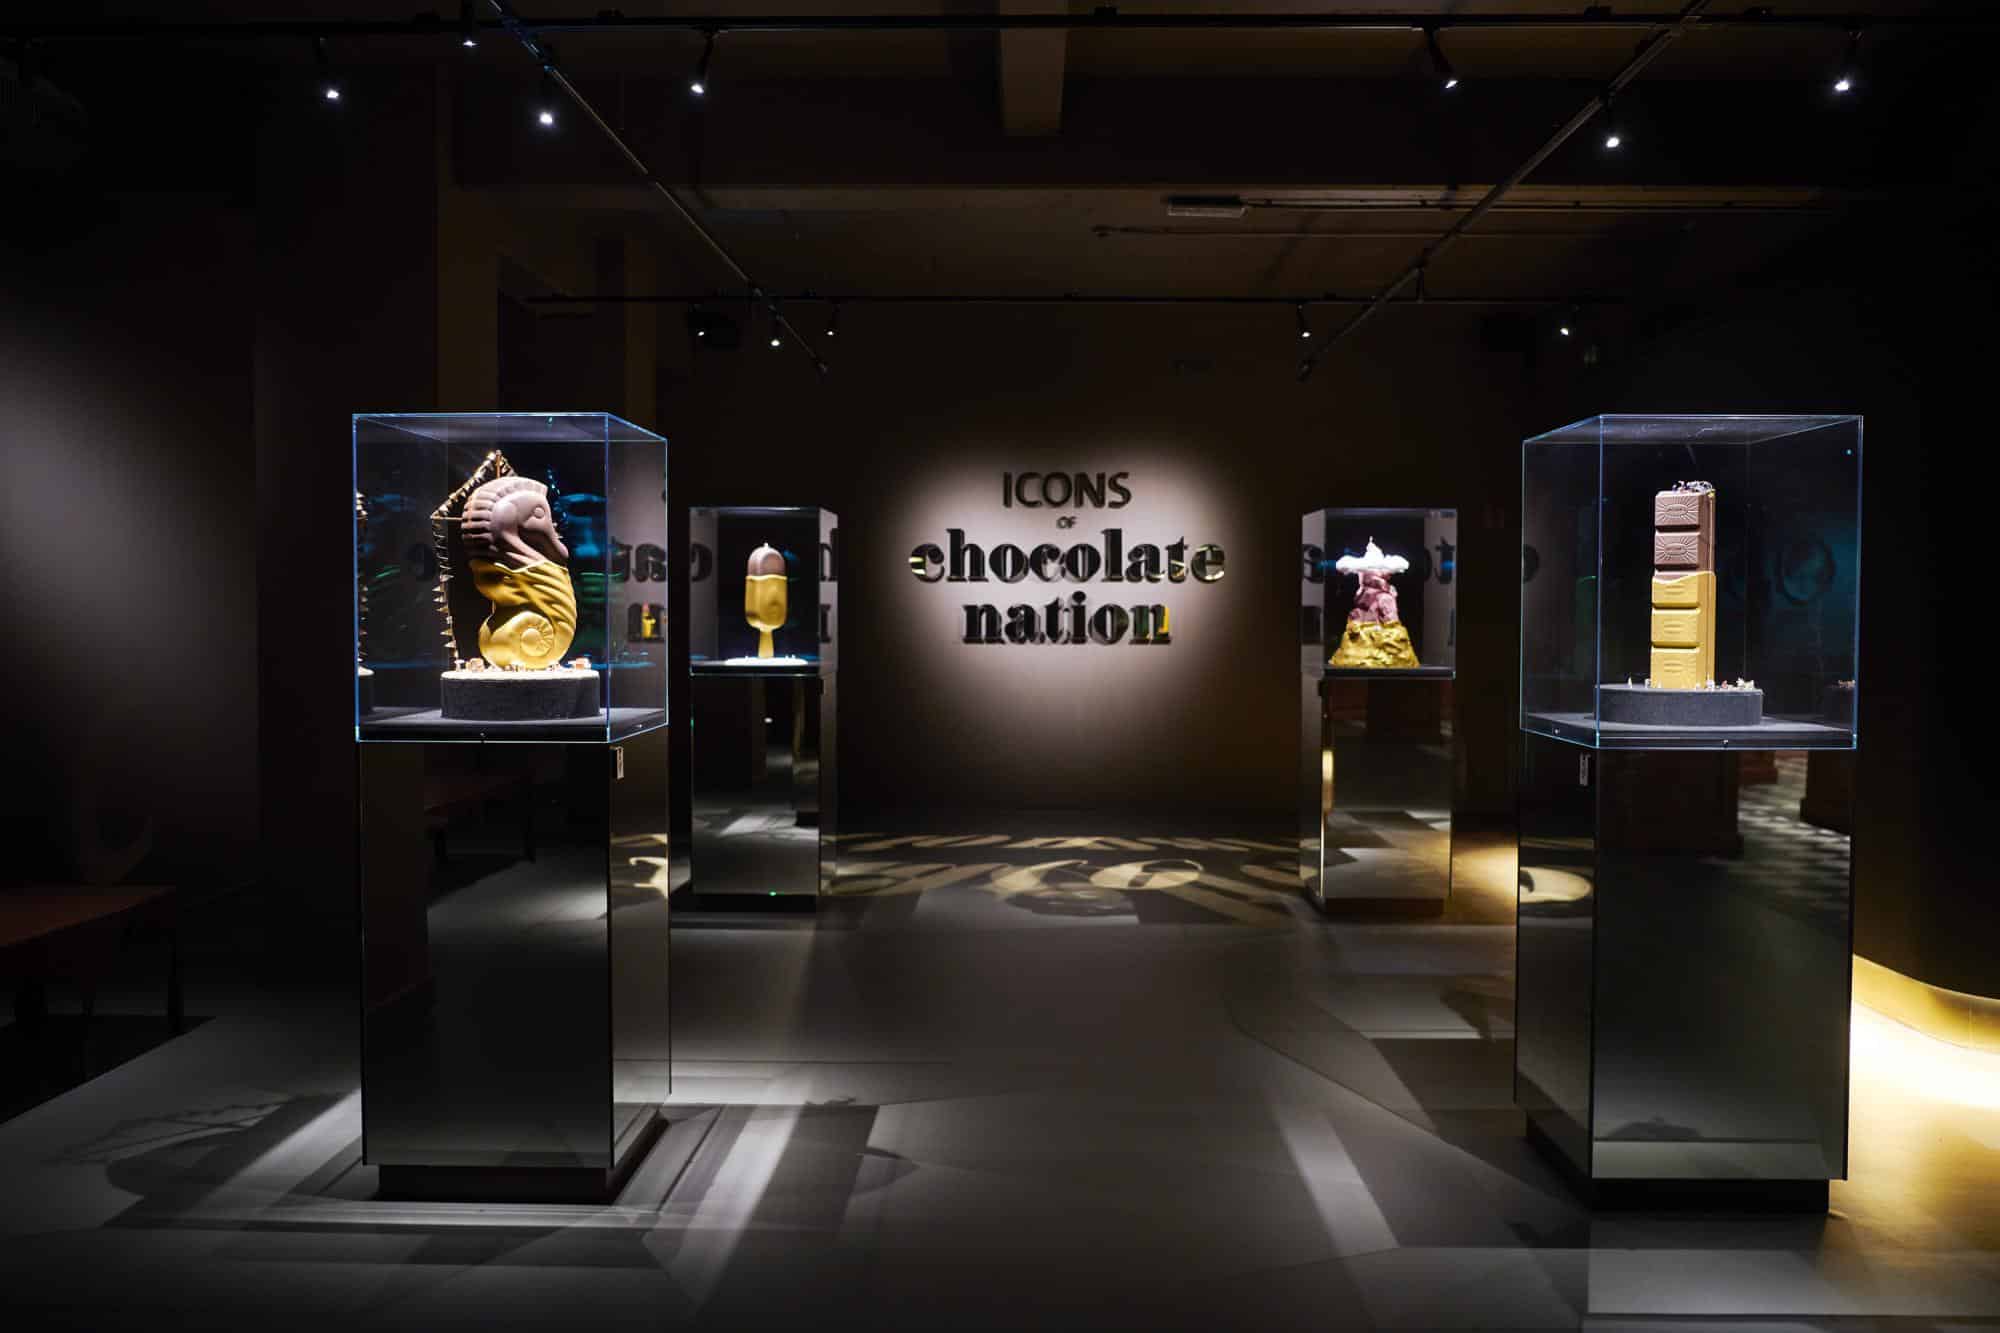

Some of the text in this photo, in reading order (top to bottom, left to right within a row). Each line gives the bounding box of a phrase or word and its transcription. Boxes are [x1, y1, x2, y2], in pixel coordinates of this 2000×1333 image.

[1003, 472, 1131, 508] ICONS
[1057, 516, 1077, 529] OF
[909, 528, 1225, 582] chocolate
[962, 591, 1171, 645] nation
